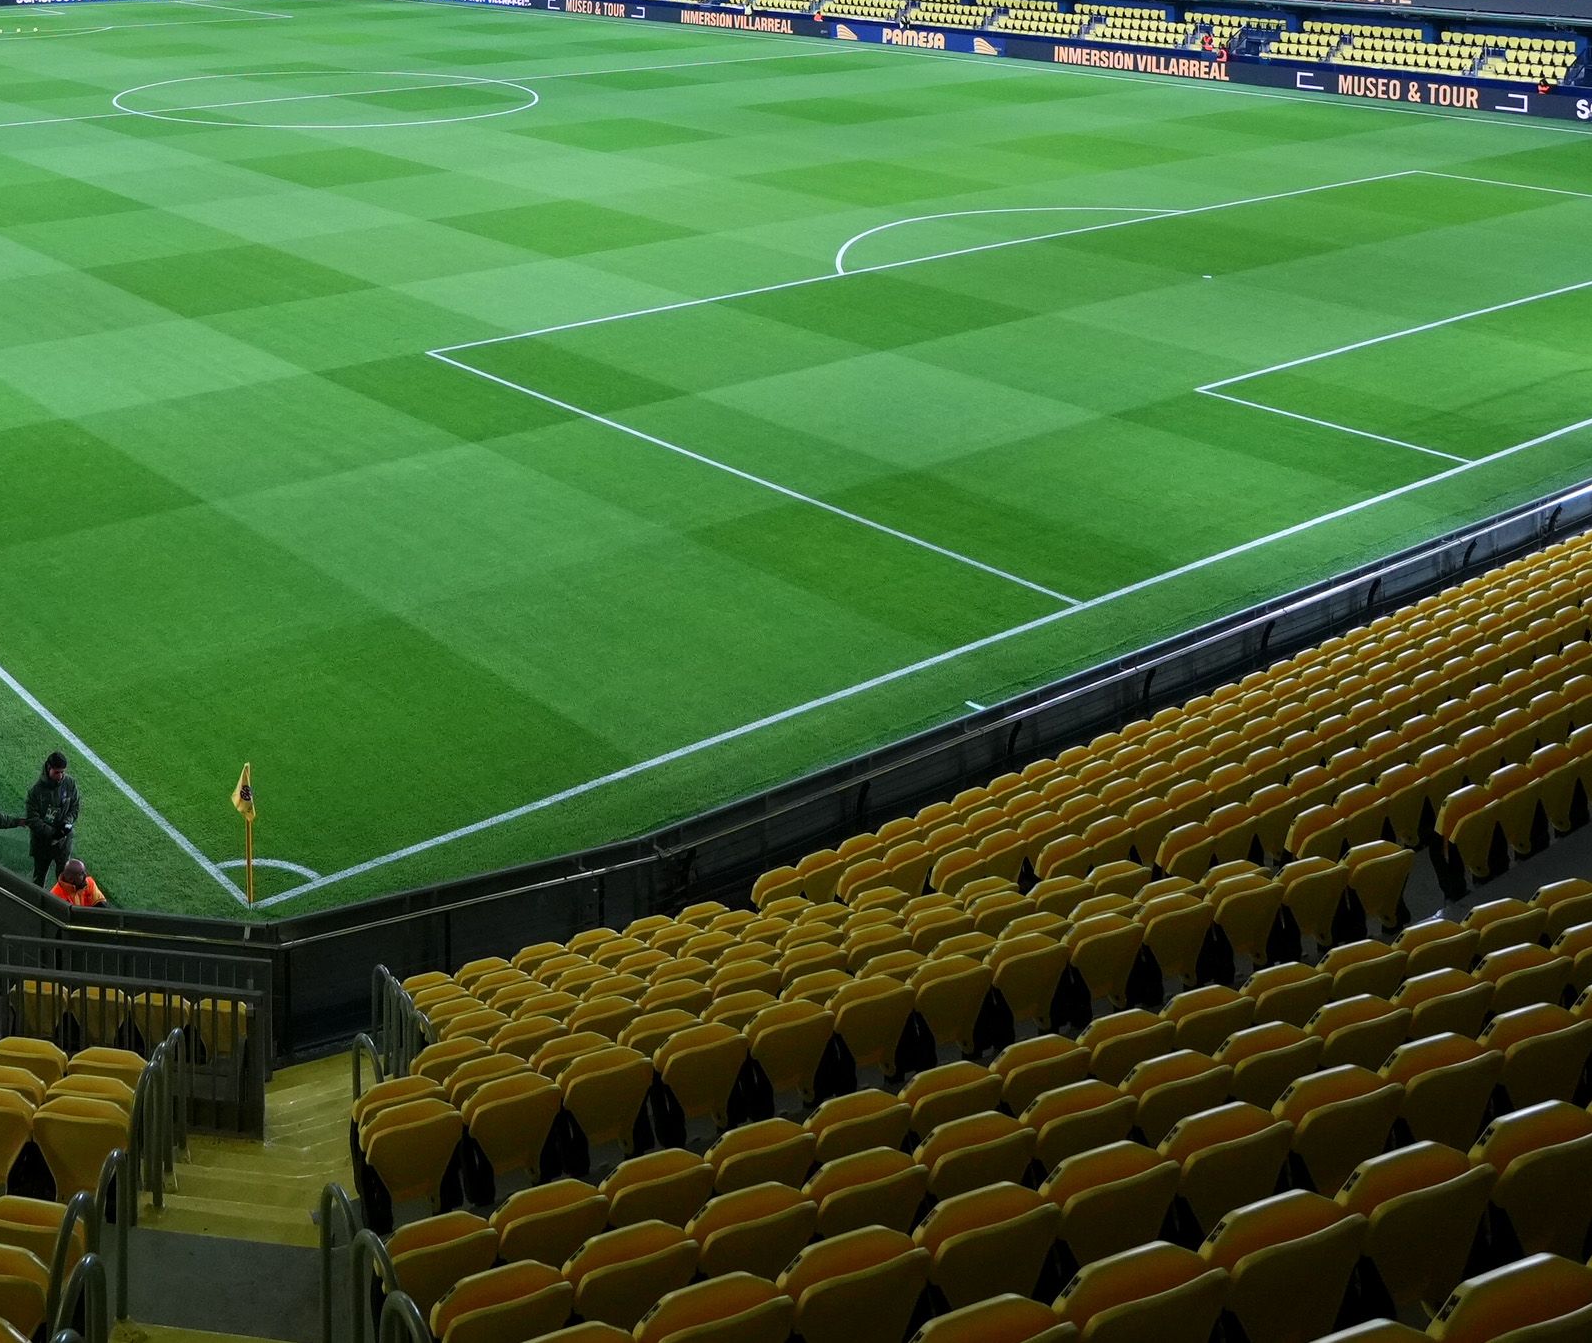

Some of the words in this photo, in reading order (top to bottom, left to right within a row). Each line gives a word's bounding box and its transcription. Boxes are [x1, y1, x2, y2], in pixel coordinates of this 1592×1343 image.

[565, 0, 592, 15] MUSEO
[594, 1, 602, 15] &
[603, 2, 625, 18] TOUR
[680, 9, 732, 28] INMERSIÓN
[733, 14, 793, 34] VILLARREAL
[882, 28, 946, 50] PAMESA
[1054, 46, 1134, 71] INMERSIÓN
[1137, 54, 1229, 82] VILLARREAL
[1338, 74, 1401, 100] MUSEO
[1407, 81, 1421, 103] &
[1427, 83, 1479, 109] TOUR
